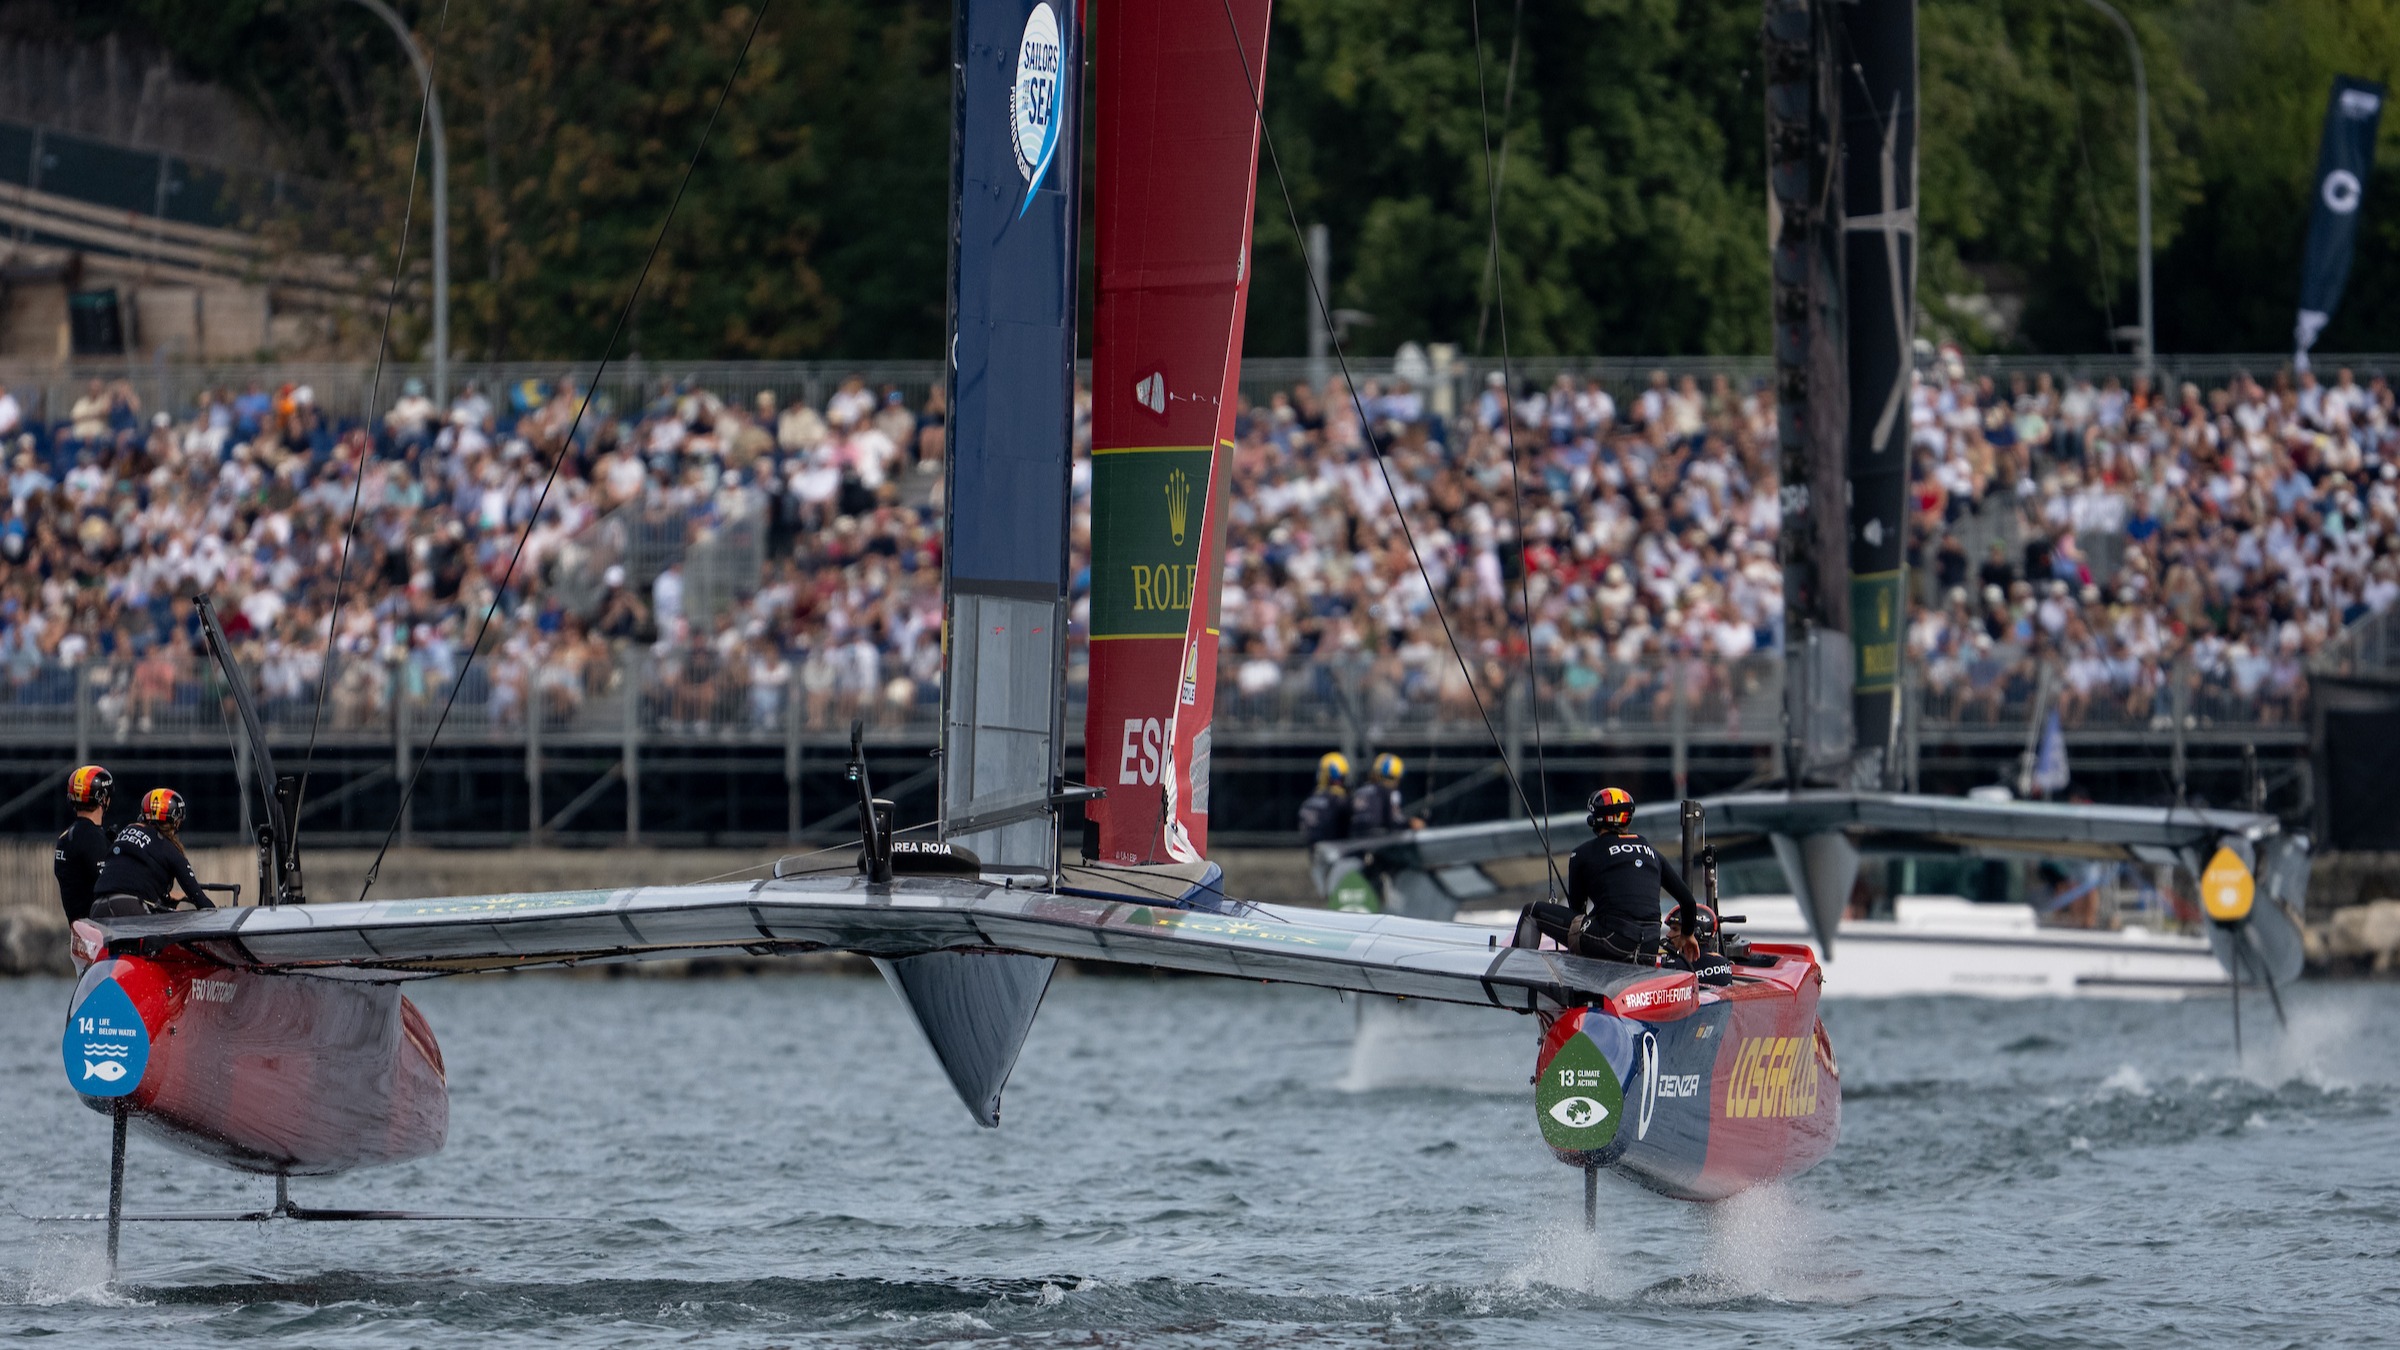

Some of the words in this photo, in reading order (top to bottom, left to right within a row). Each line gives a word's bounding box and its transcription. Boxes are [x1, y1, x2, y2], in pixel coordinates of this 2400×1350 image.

[1024, 40, 1058, 74] SAILORS
[1028, 76, 1053, 127] SEA
[1009, 85, 1018, 143] POWERED
[127, 828, 152, 846] DER
[921, 842, 952, 855] ROJA
[191, 978, 207, 1001] F50
[1626, 986, 1693, 1009] #RACEFORTHEFUTURE
[79, 1017, 95, 1035] 14
[98, 1018, 110, 1026] LIFE
[98, 1027, 118, 1036] BELOW
[118, 1029, 137, 1037] WATER
[1558, 1069, 1575, 1088] 13
[1577, 1069, 1601, 1078] CLIMATE
[1577, 1079, 1598, 1088] ACTION
[1657, 1073, 1701, 1098] DENZA
